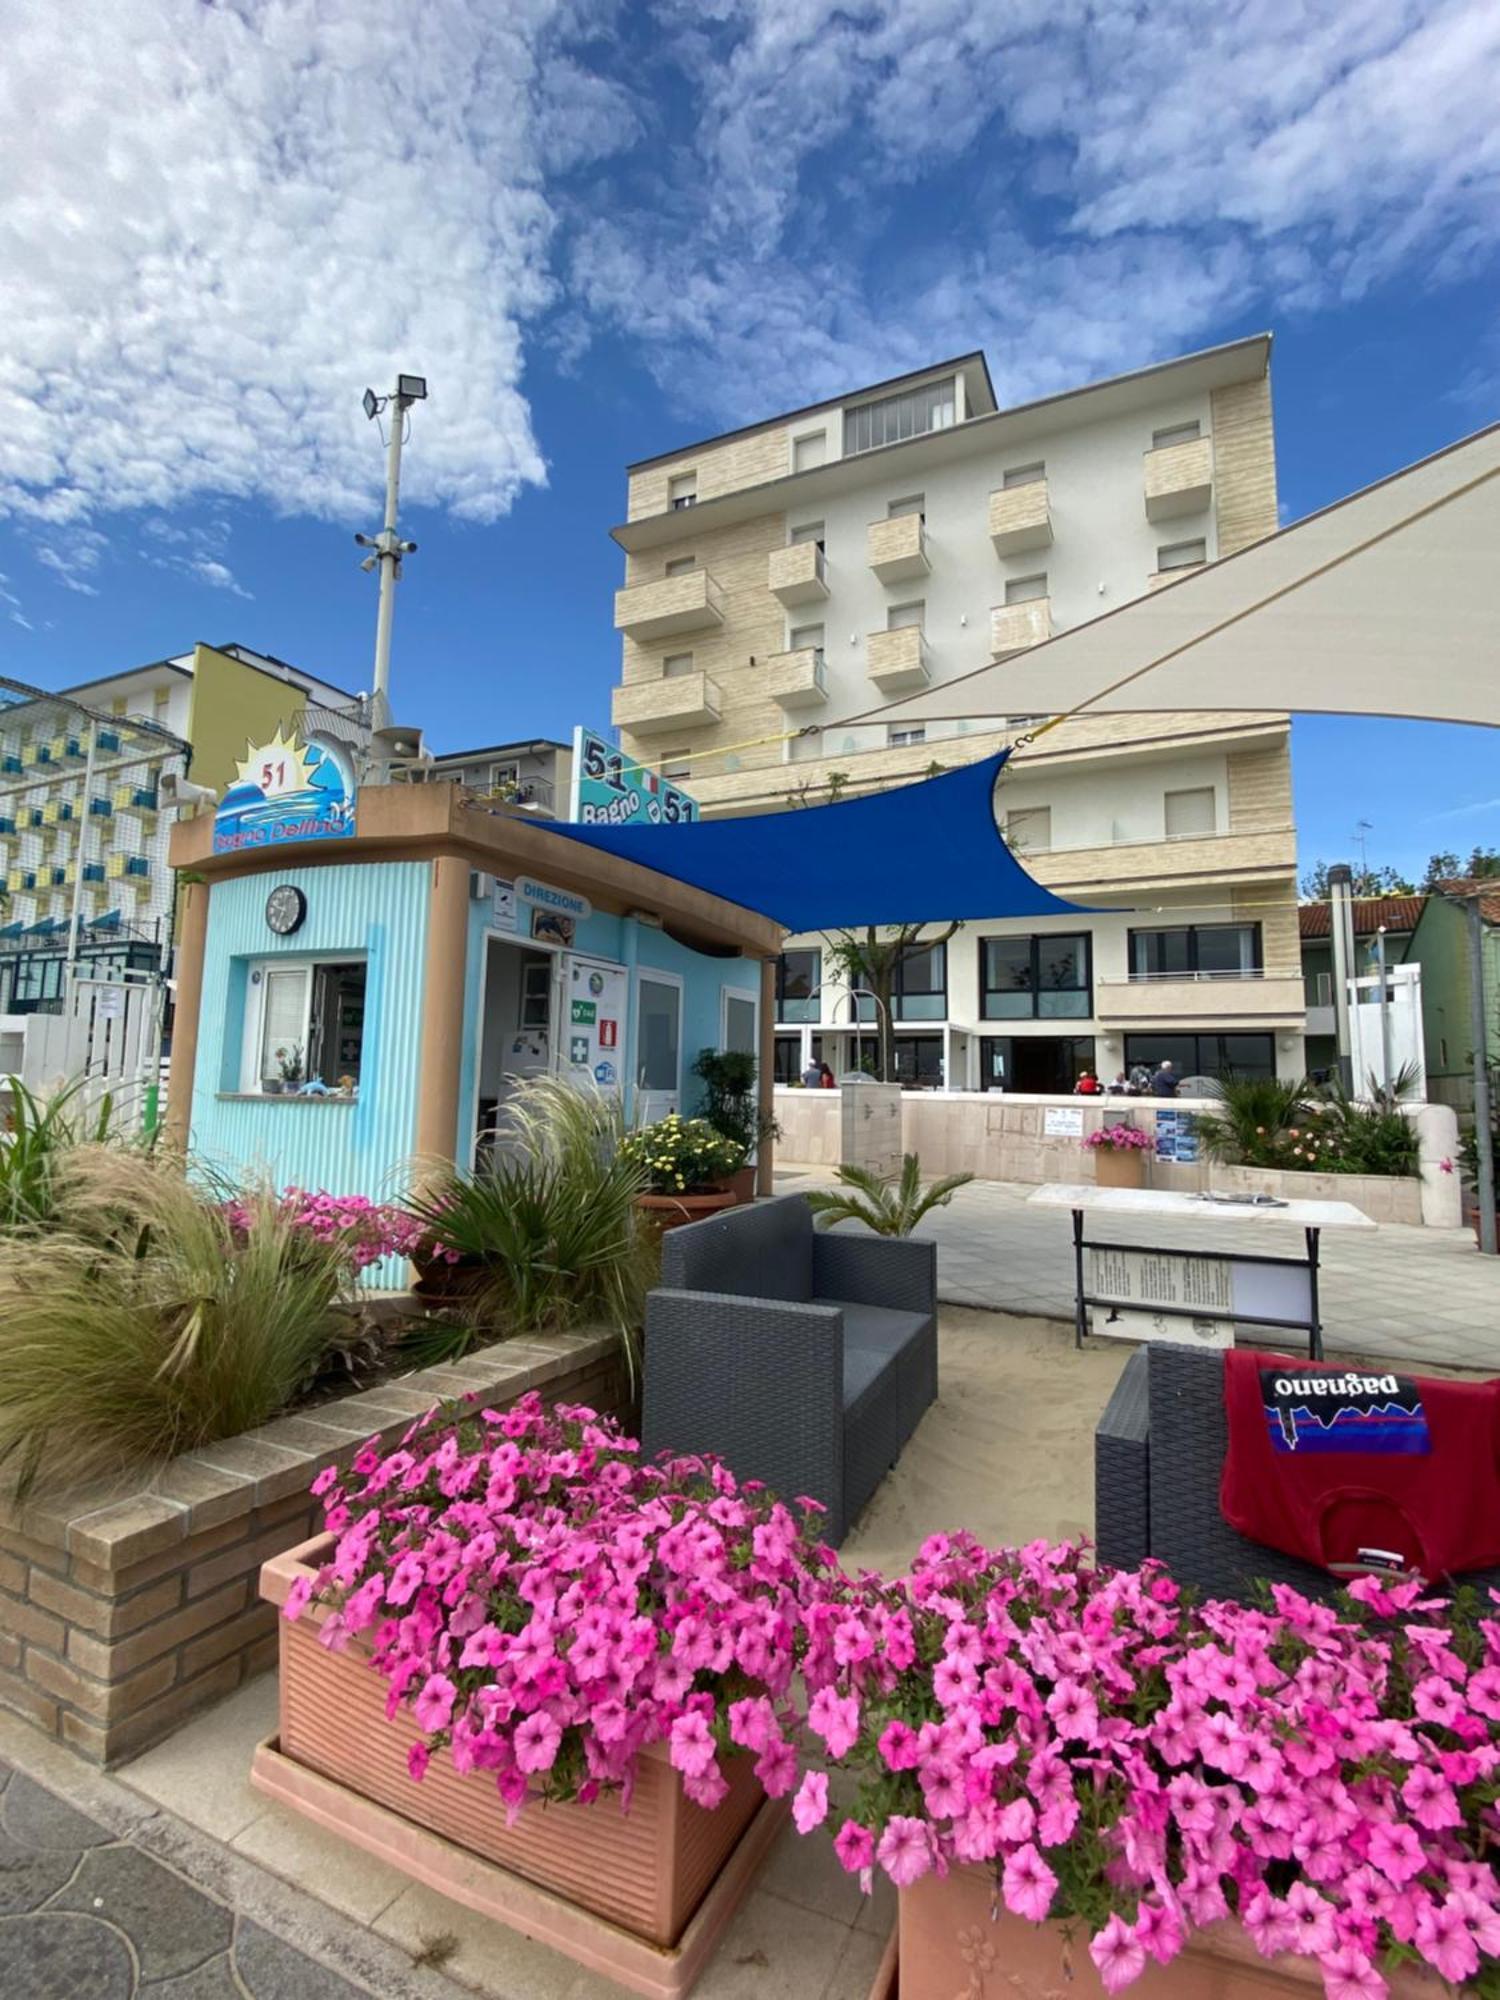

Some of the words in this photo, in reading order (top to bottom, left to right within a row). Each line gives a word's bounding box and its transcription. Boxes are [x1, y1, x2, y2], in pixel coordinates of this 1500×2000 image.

[261, 761, 285, 789] 51
[584, 737, 627, 793] 51
[582, 790, 641, 824] Bagno
[664, 788, 694, 824] 51
[523, 882, 584, 913] DIREZIONE
[1274, 1372, 1400, 1397] pagnano
